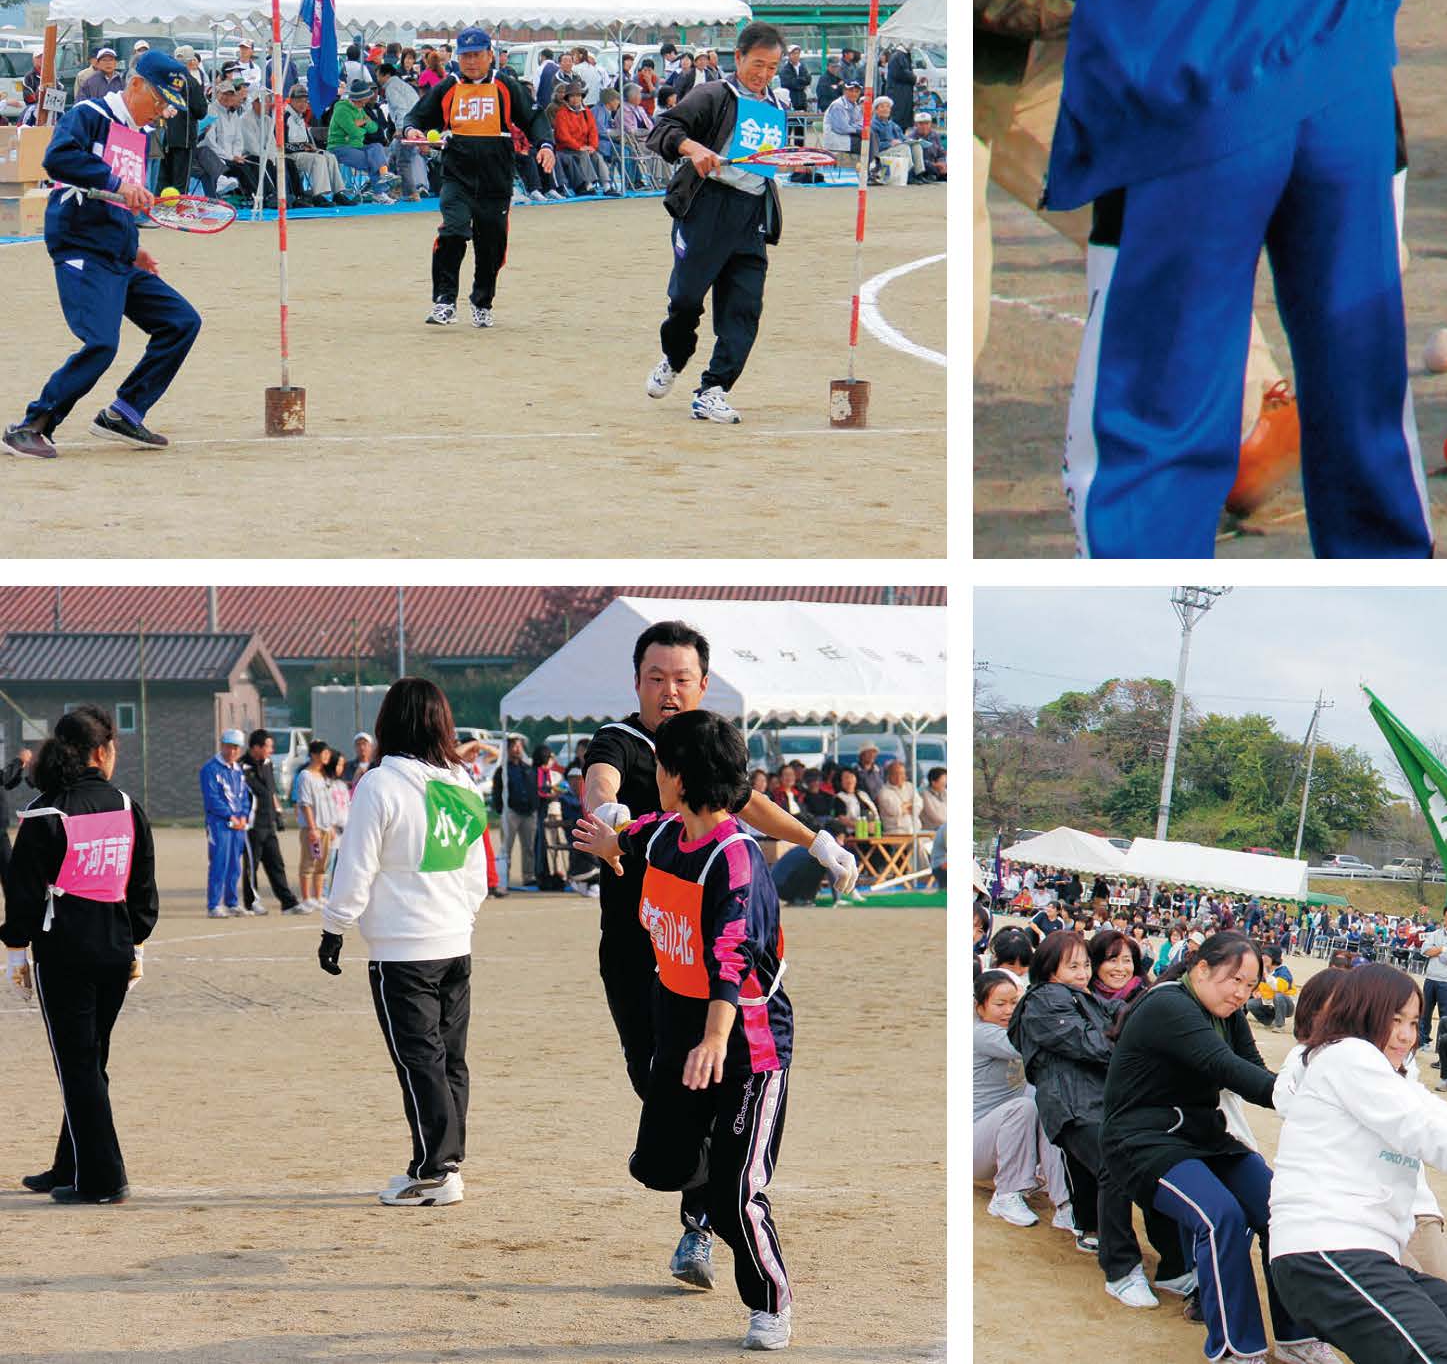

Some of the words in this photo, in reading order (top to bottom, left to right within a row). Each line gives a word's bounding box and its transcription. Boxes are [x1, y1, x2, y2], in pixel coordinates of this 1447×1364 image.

[453, 96, 496, 122] 上河戸
[739, 118, 783, 152] 金枝
[72, 834, 131, 877] 下河戸南
